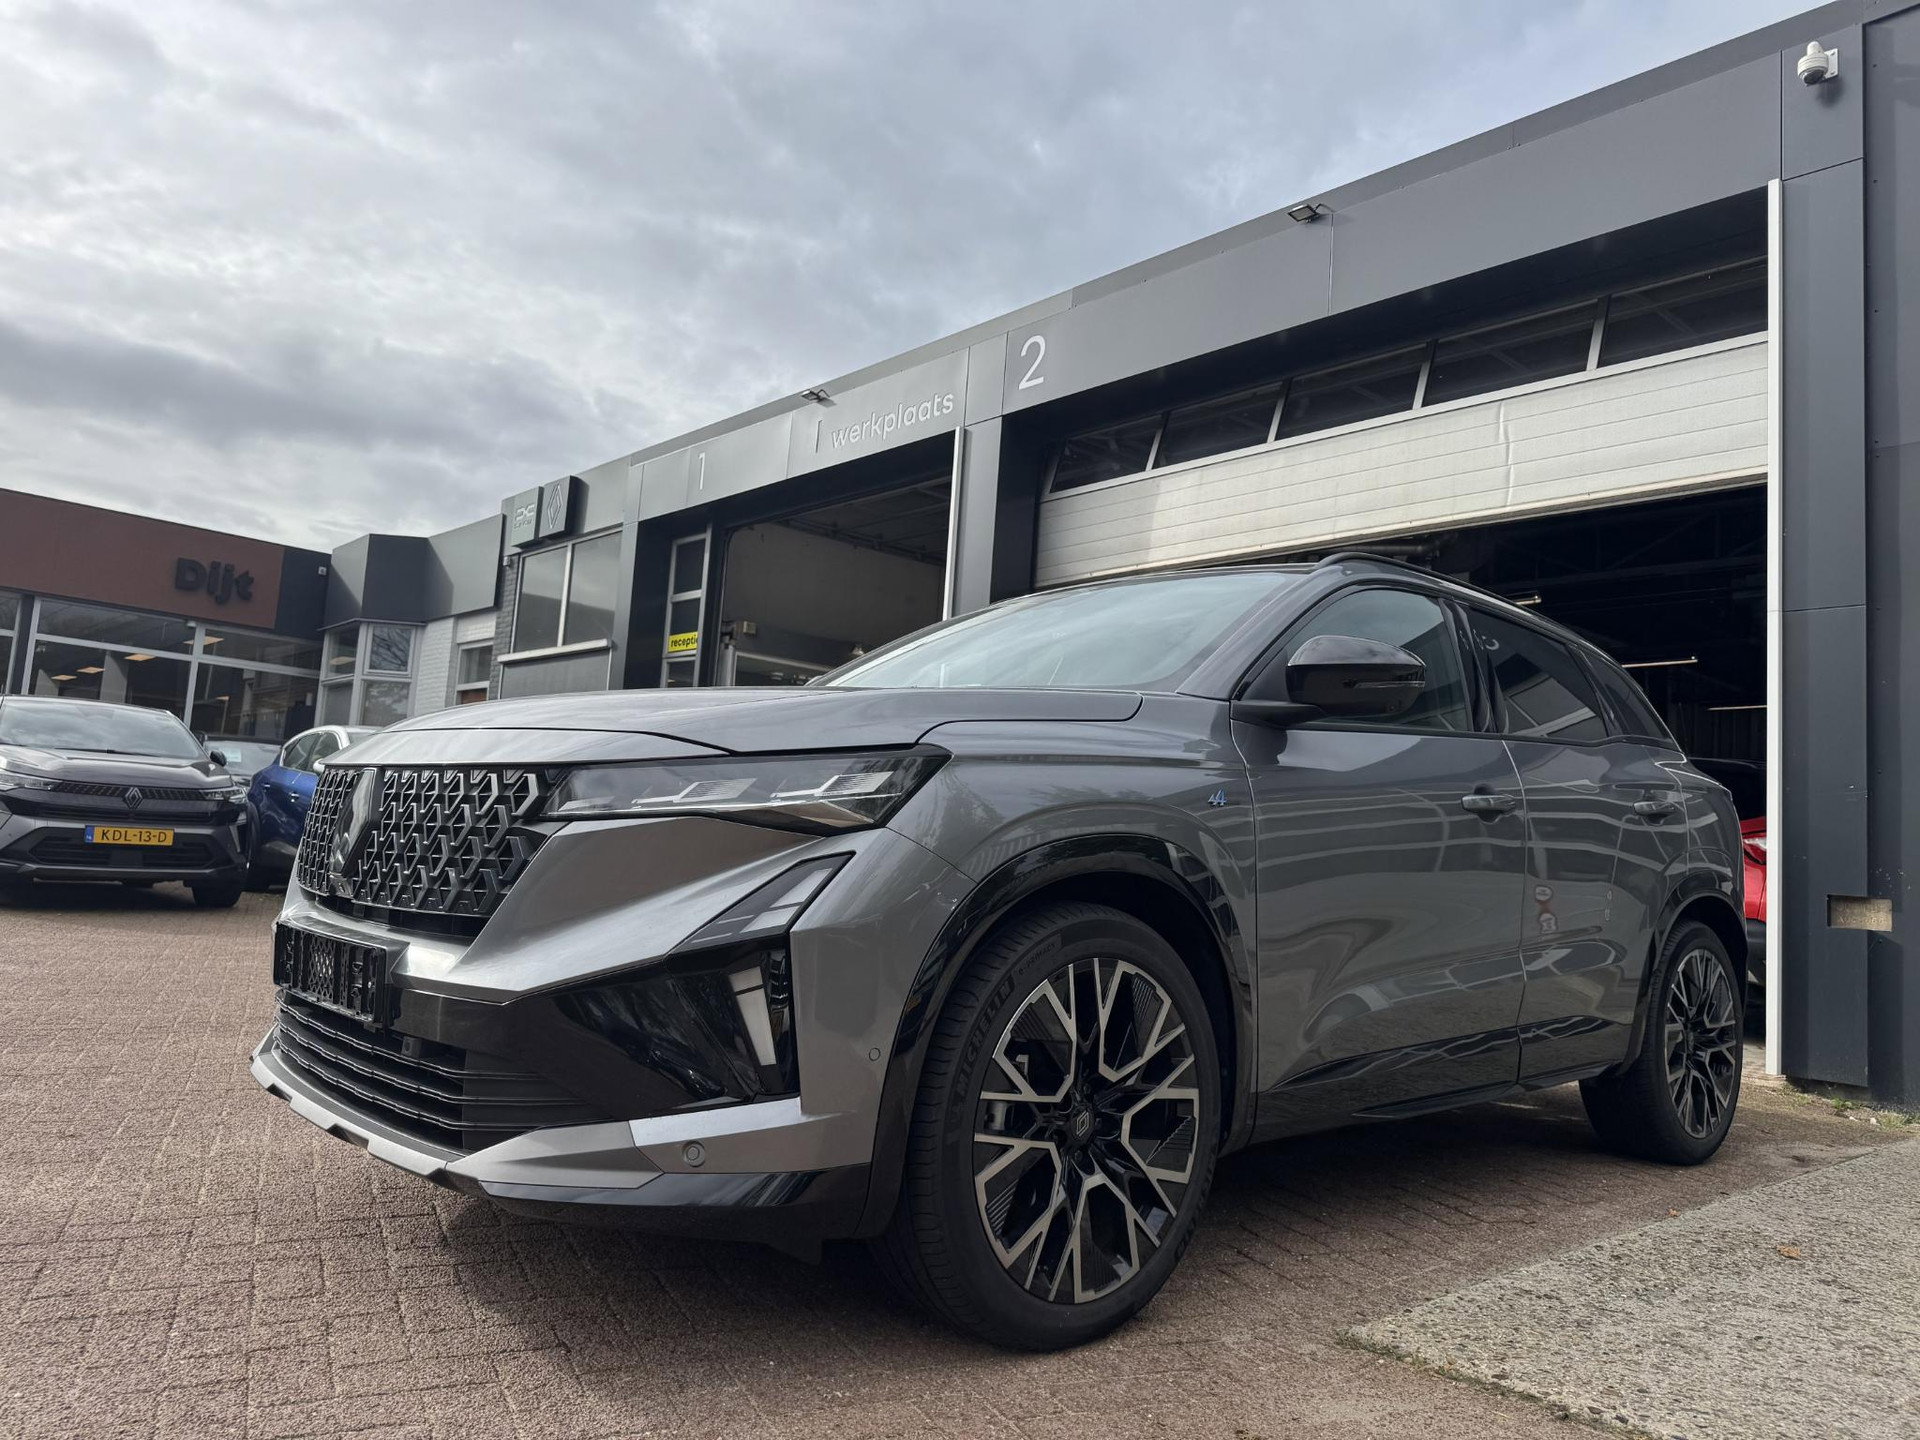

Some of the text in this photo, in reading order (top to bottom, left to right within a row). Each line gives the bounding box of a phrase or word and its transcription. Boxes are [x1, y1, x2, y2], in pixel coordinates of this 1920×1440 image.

[1018, 335, 1047, 391] 2
[831, 393, 955, 449] werkplaats
[698, 451, 706, 491] 1
[101, 828, 167, 843] KDL-13-D
[954, 974, 1015, 1101] MICHELIN
